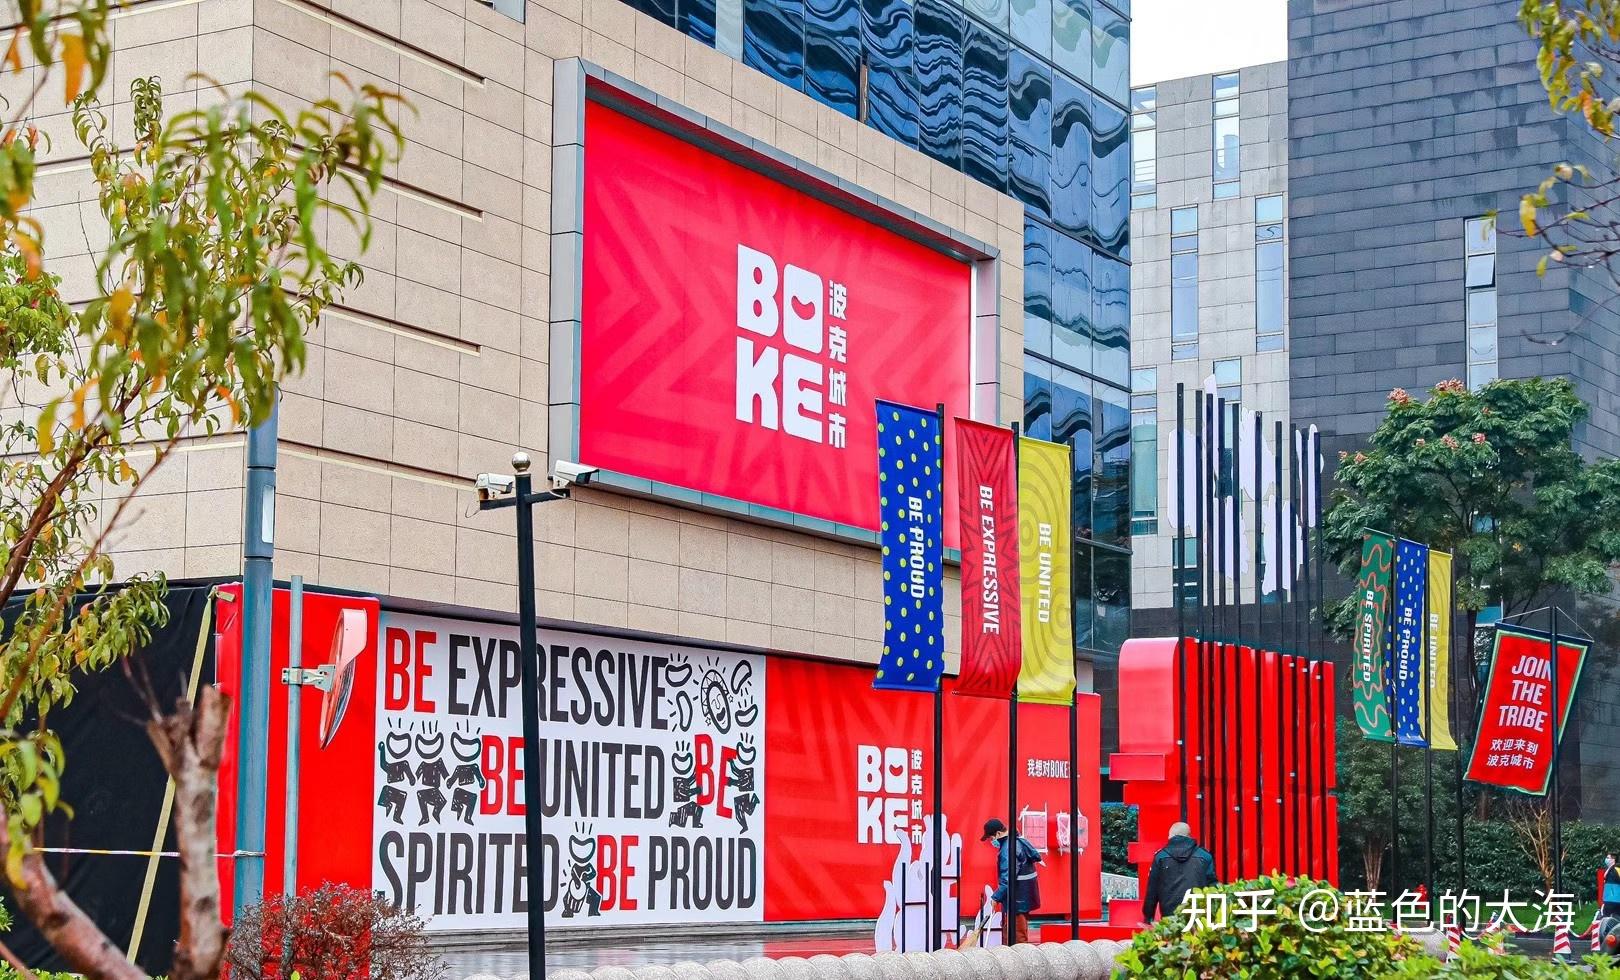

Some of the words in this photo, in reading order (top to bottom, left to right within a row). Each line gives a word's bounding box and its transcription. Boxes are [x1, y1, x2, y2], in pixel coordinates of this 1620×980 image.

[829, 280, 847, 448] 波克城市
[909, 496, 923, 523] BE
[980, 485, 994, 511] BE
[1039, 523, 1051, 548] BE
[910, 527, 925, 599] PROUD
[981, 515, 999, 634] EXPRESSIVE
[1039, 552, 1051, 623] UNITED
[1365, 590, 1374, 609] BE
[1403, 607, 1412, 626] BE
[1430, 613, 1438, 631] BE
[1363, 613, 1372, 682] SPIRITED
[1399, 629, 1411, 680] PROUD
[1430, 635, 1438, 688] UNITED
[384, 626, 437, 713] BE
[1511, 655, 1552, 681] JOIN
[1511, 680, 1546, 705] THE
[1498, 705, 1548, 732] TRIBE
[1486, 754, 1535, 769] 波克城市
[1490, 739, 1538, 755] 欢迎来到
[480, 735, 528, 816] BE
[539, 738, 665, 820] UNITED
[694, 733, 737, 819] BE
[912, 748, 922, 845] 波克城市
[379, 830, 560, 915] SPIRITED
[597, 835, 639, 911] BE
[648, 835, 757, 911] PROUD
